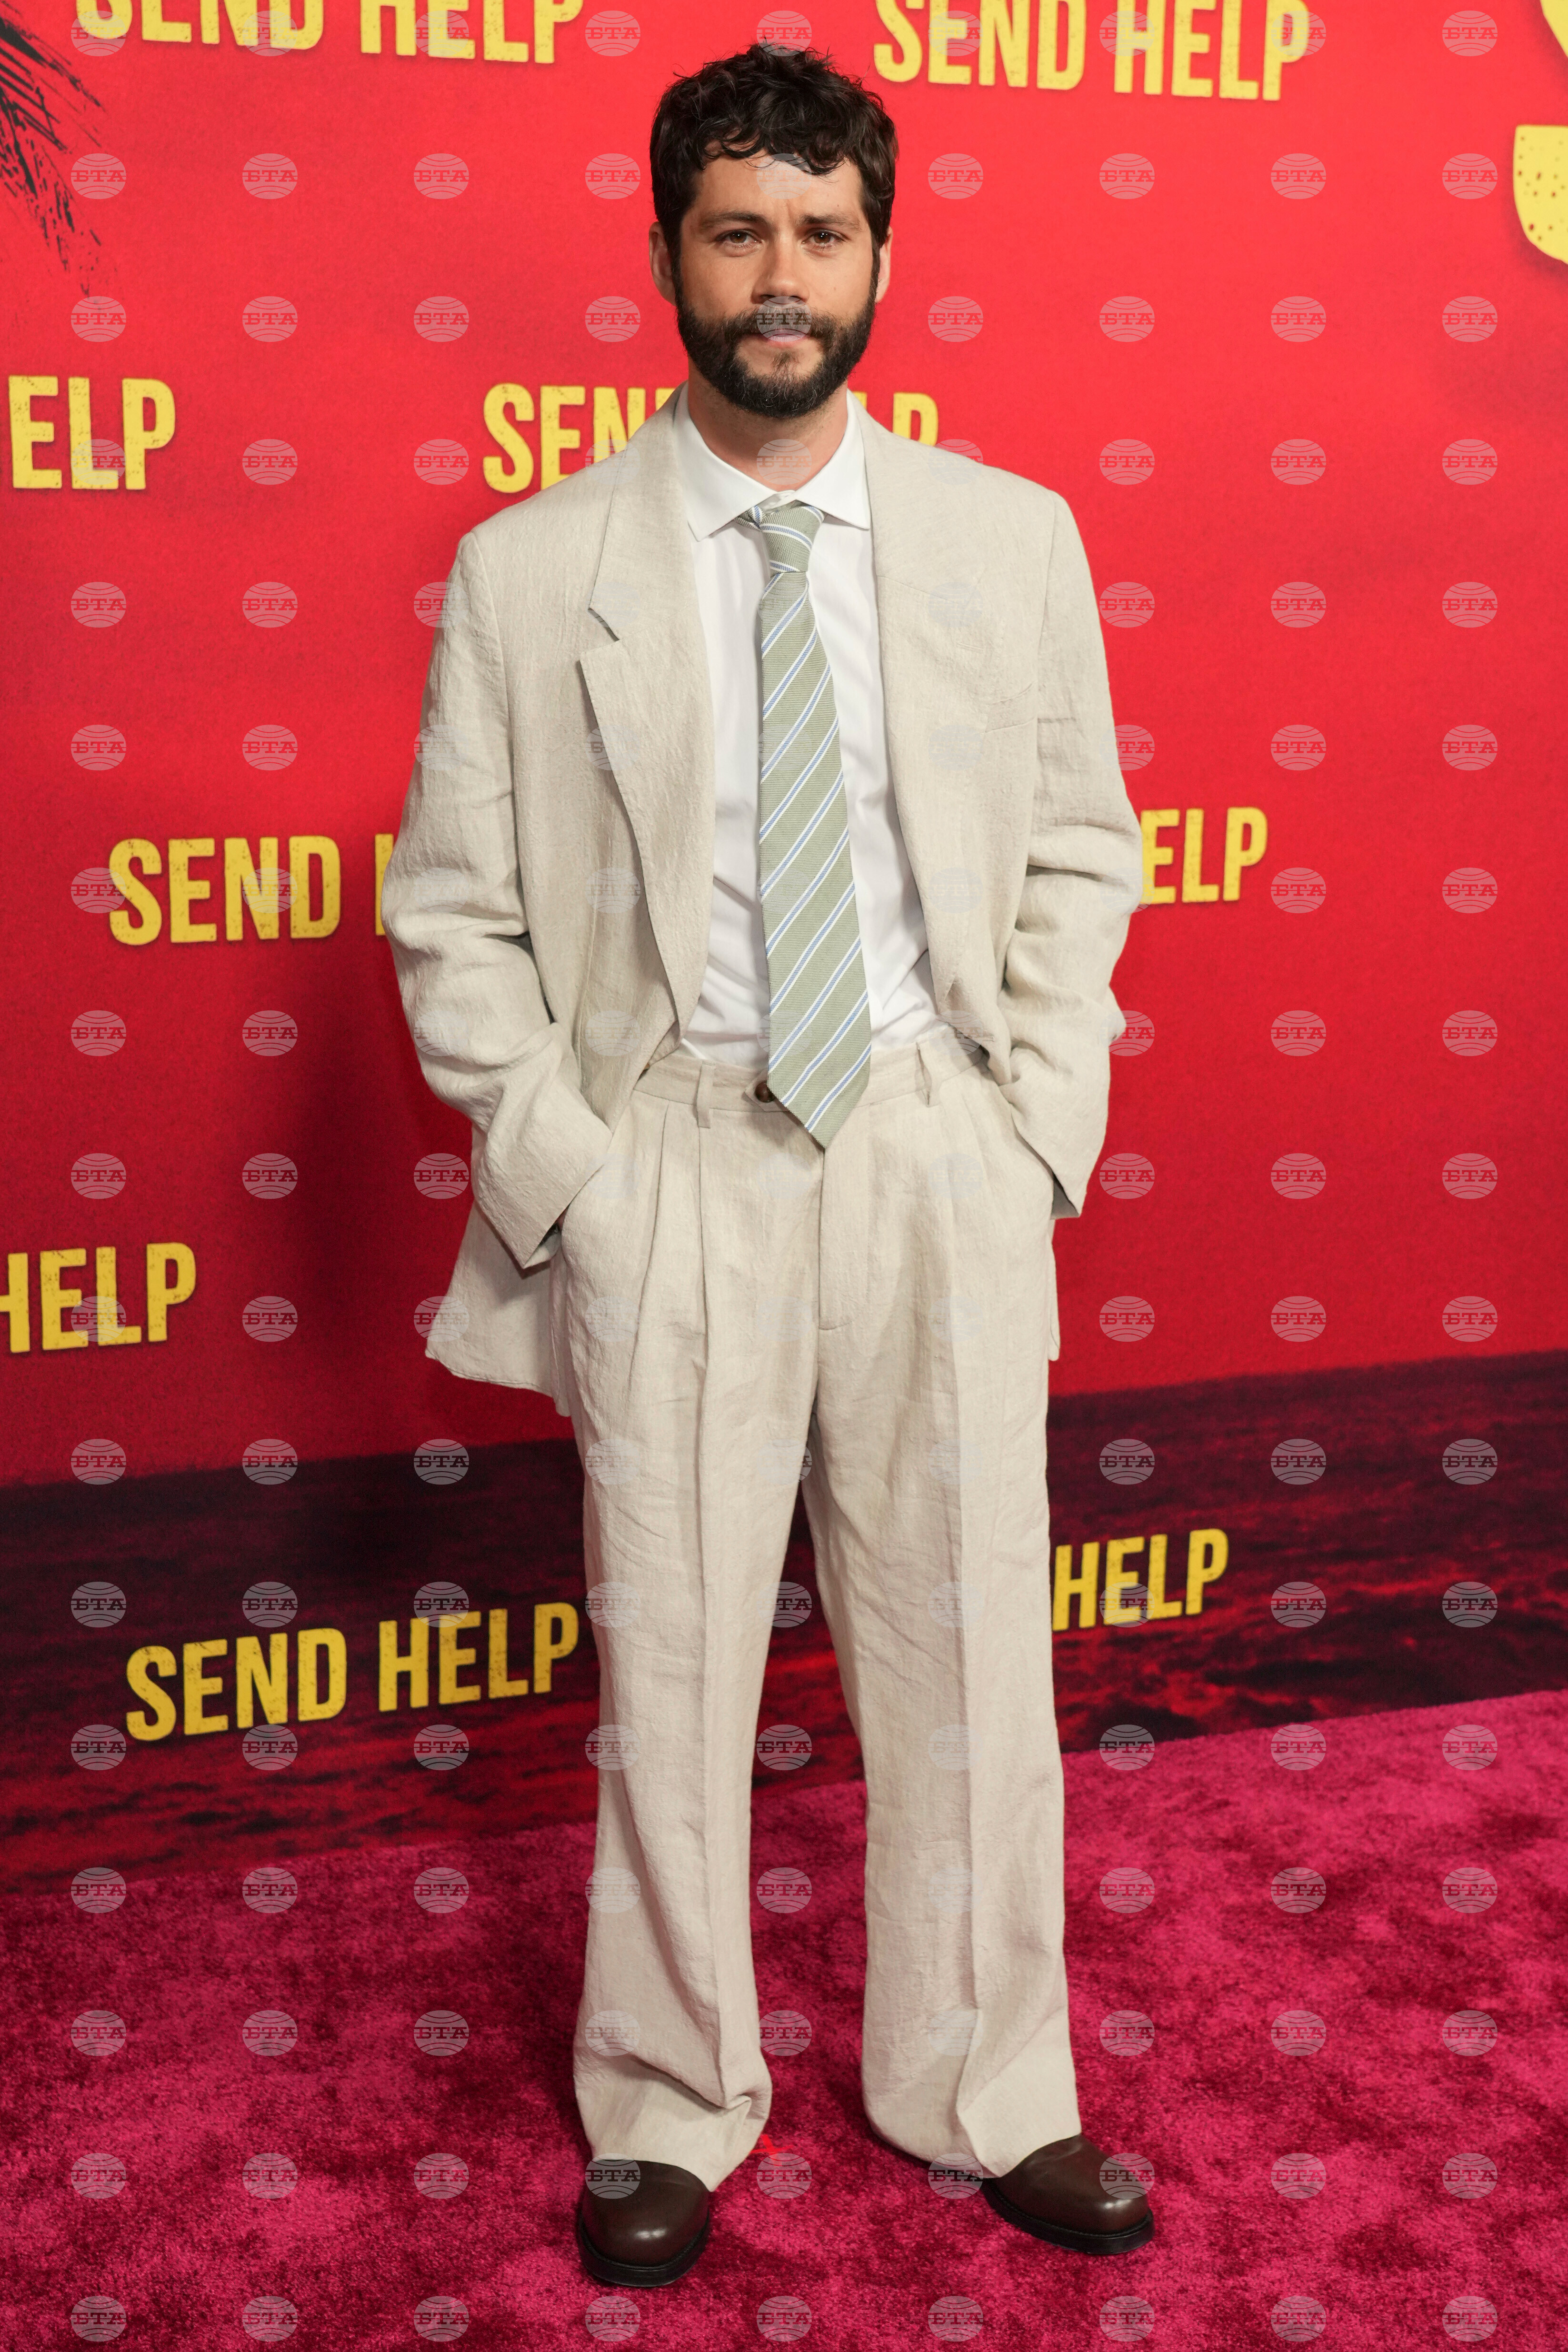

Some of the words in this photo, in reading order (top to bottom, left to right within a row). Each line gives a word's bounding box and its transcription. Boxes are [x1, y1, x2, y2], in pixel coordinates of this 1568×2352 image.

[874, 0, 1086, 90] SEND
[1114, 0, 1309, 101] HELP
[9, 375, 176, 490] ELP
[483, 383, 675, 493] SEN
[108, 835, 341, 945] SEND
[1140, 807, 1268, 904] ELP
[0, 1242, 196, 1353] HELP
[1051, 1528, 1229, 1632] HELP
[126, 1627, 348, 1741] SEND
[379, 1601, 579, 1712] HELP
